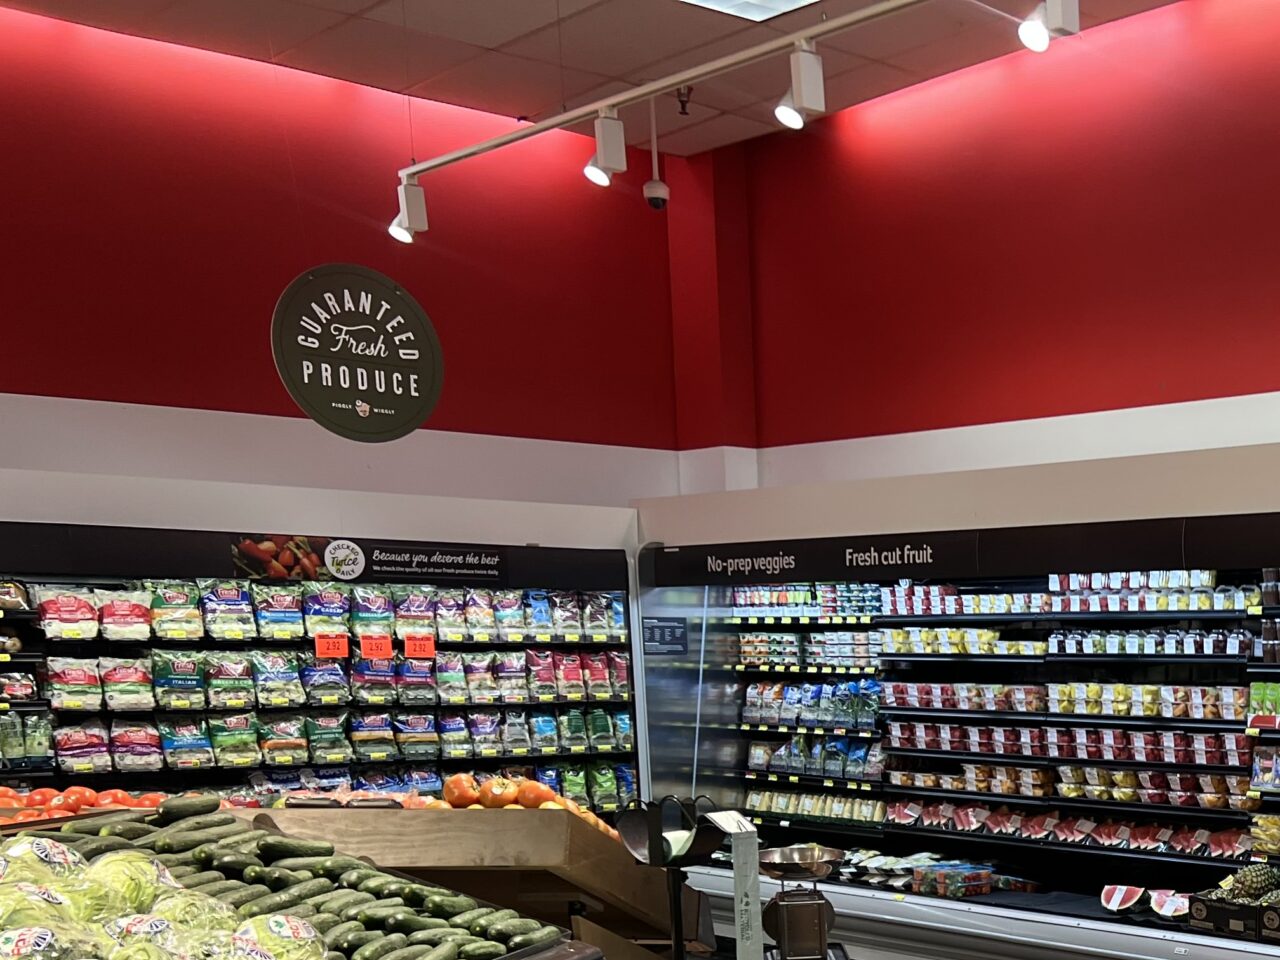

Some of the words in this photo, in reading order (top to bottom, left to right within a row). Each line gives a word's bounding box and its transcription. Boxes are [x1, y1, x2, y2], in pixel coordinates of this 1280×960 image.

[297, 289, 420, 360] GUARANTEED
[330, 324, 389, 358] Fresh
[302, 360, 420, 397] PRODUCE
[331, 554, 360, 567] Twice
[372, 550, 410, 562] Because
[412, 553, 429, 567] you
[430, 552, 464, 564] deserve
[465, 552, 479, 564] the
[480, 553, 500, 565] best
[706, 554, 752, 576] No-prep
[753, 551, 796, 574] veggies
[845, 546, 879, 567] Fresh
[881, 546, 902, 565] cut
[903, 543, 934, 564] fruit
[335, 568, 356, 577] DAILY
